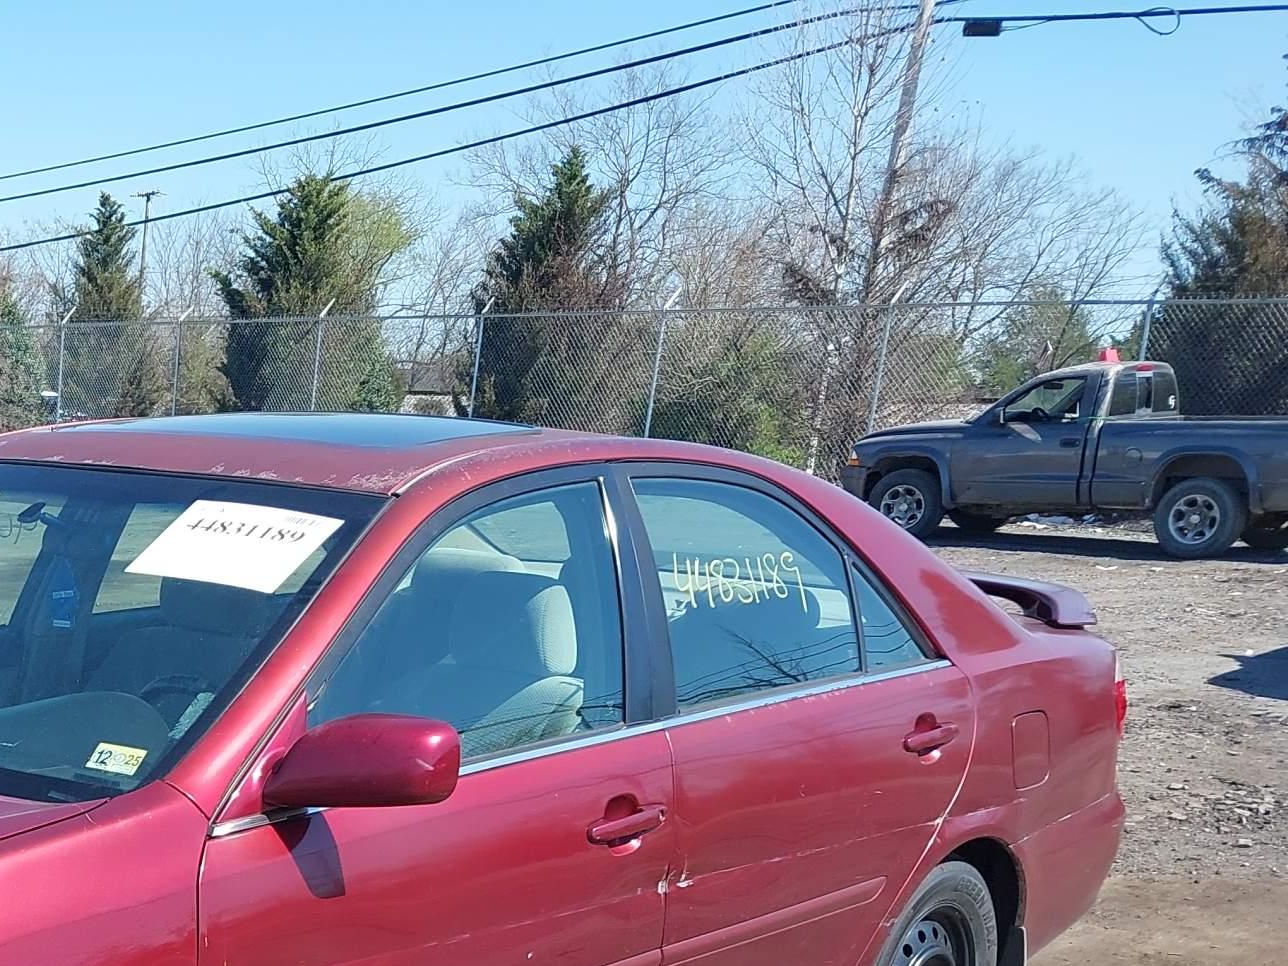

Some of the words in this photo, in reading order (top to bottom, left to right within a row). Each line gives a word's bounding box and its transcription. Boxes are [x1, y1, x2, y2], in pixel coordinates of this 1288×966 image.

[186, 518, 307, 544] 44831189
[673, 551, 808, 614] 44831189
[94, 750, 113, 765] 12
[124, 754, 142, 767] 25
